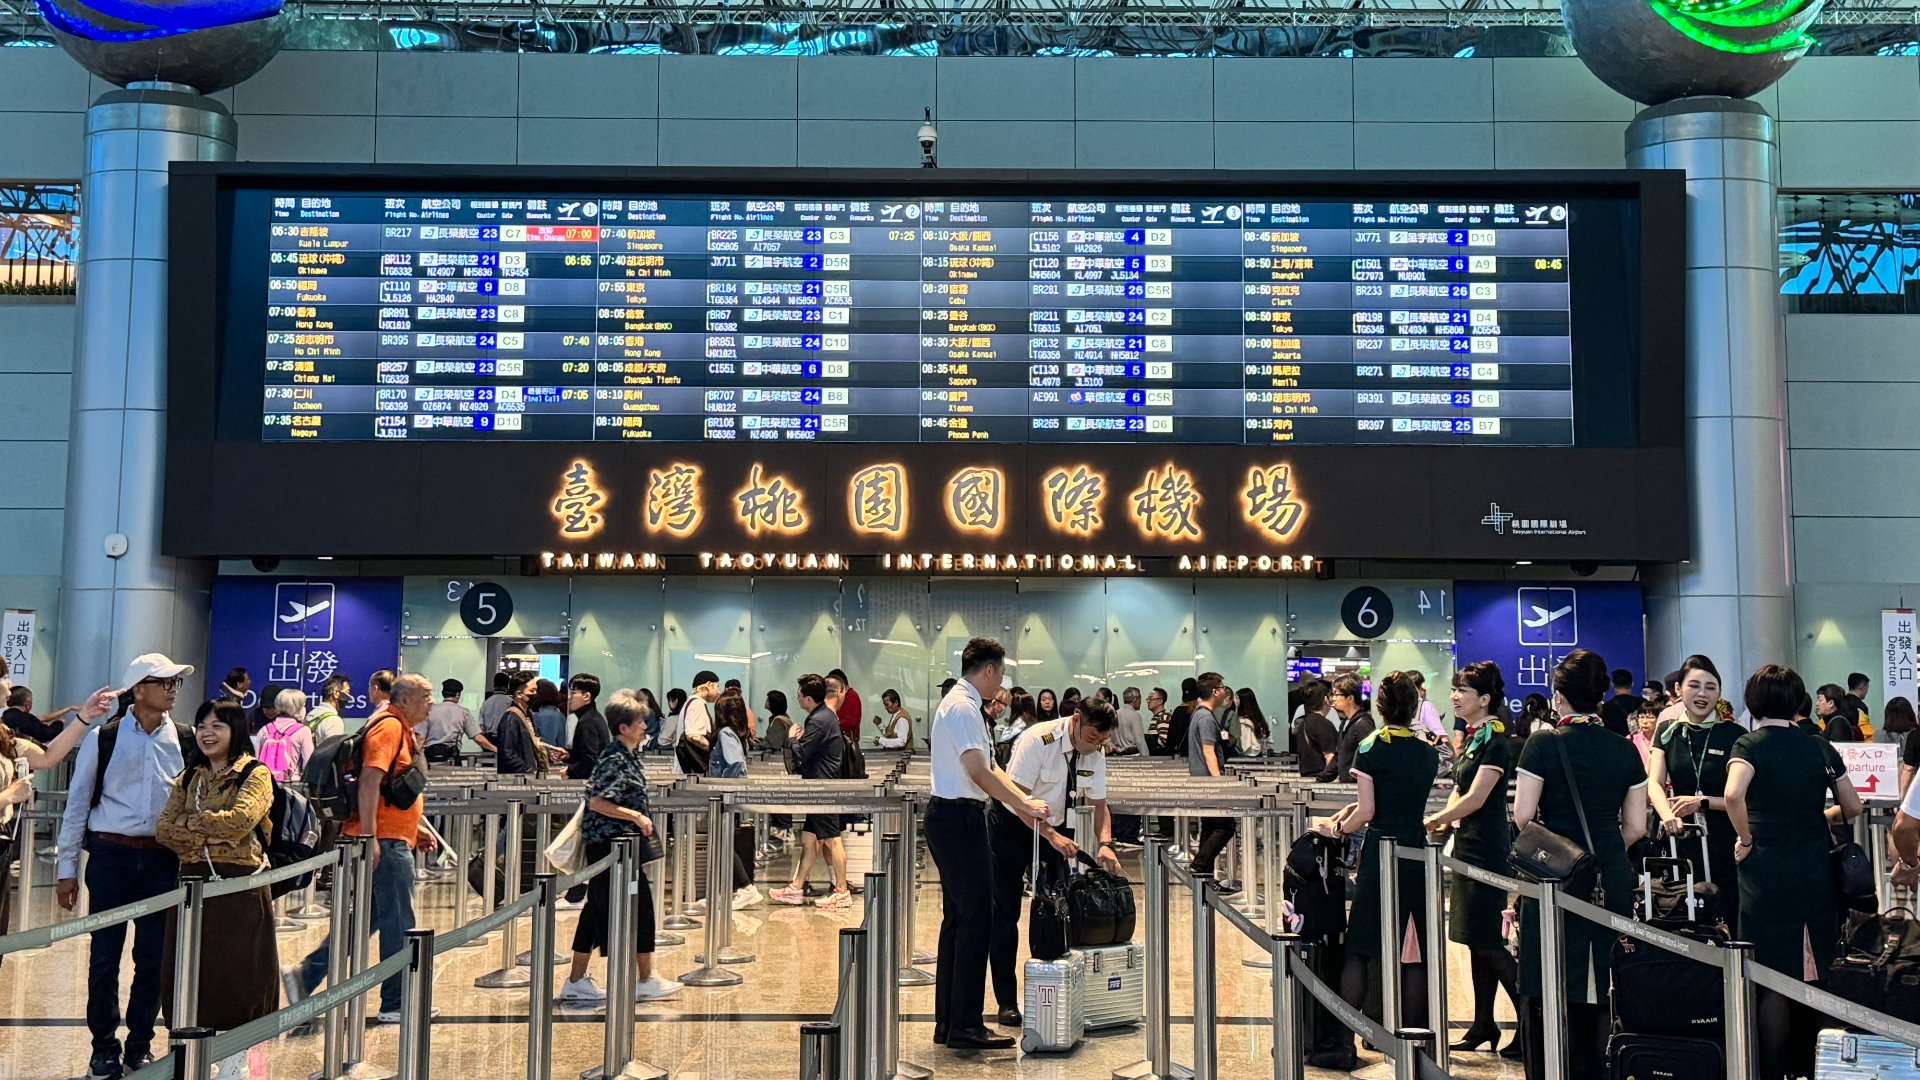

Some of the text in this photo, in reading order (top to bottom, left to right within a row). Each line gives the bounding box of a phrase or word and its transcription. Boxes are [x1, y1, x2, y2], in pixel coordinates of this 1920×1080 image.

[301, 198, 331, 209] 目的地
[421, 199, 461, 210] 航空公司
[272, 227, 298, 236] 06:30
[505, 228, 521, 239] C7
[601, 229, 626, 239] 07:40
[829, 231, 845, 241] C3
[923, 231, 948, 240] 08:10
[1150, 232, 1166, 242] D2
[1245, 232, 1270, 241] 08:45
[1471, 233, 1494, 243] D10
[271, 254, 298, 263] 06:45
[504, 255, 521, 266] D3
[600, 256, 626, 266] 07:40
[825, 257, 848, 267] D5R
[923, 258, 948, 267] 08:15
[1150, 258, 1166, 269] D3
[1245, 259, 1270, 268] 08:50
[1474, 259, 1490, 270] A9
[270, 281, 296, 290] 06:50
[504, 282, 520, 292] D8
[825, 284, 848, 294] C5R
[923, 284, 948, 294] 08:20
[1147, 285, 1170, 295] C5R
[1245, 285, 1271, 295] 08:50
[1475, 286, 1491, 296] C3
[269, 308, 295, 317] 07:00
[503, 309, 519, 319] C8
[599, 310, 624, 320] 08:05
[828, 311, 843, 320] C1
[922, 311, 948, 321] 08:25
[1150, 311, 1167, 322] C2
[1246, 312, 1271, 322] 08:50
[1476, 313, 1492, 323] D4
[268, 335, 294, 344] 07:25
[502, 336, 519, 346] C5
[598, 337, 624, 346] 08:05
[824, 337, 847, 348] C10
[922, 338, 948, 347] 08:30
[1151, 339, 1167, 349] C8
[1246, 339, 1271, 349] 09:00
[1477, 340, 1492, 350] B9
[267, 362, 293, 371] 07:25
[497, 362, 521, 373] C5R
[598, 364, 624, 373] 08:05
[828, 364, 843, 374] D8
[922, 364, 948, 374] 08:35
[1151, 365, 1167, 375] D5
[1246, 366, 1272, 375] 09:10
[1477, 367, 1493, 377] C4
[266, 389, 292, 398] 07:30
[501, 390, 517, 400] D4
[597, 390, 623, 400] 08:10
[827, 391, 843, 401] B8
[922, 391, 948, 401] 08:40
[1147, 392, 1171, 402] C5R
[1246, 393, 1272, 402] 09:10
[1478, 394, 1494, 404] C6
[264, 416, 291, 425] 07:35
[497, 417, 520, 427] D10
[596, 417, 622, 427] 08:10
[823, 418, 847, 428] C5R
[922, 418, 948, 428] 08:45
[1152, 419, 1168, 429] D6
[1246, 420, 1272, 429] 09:15
[1479, 421, 1494, 431] B7
[550, 461, 1307, 537] 臺灣桃園國際機場
[542, 553, 1314, 570] TAIWAN TAOYUAN INTERNATIONAL AIRPORT
[476, 592, 497, 625] 5
[1357, 596, 1378, 629] 6
[14, 620, 29, 675] 出發入口
[1898, 620, 1912, 681] 出發入口
[268, 649, 339, 683] 出發
[1886, 635, 1898, 687] Departure
